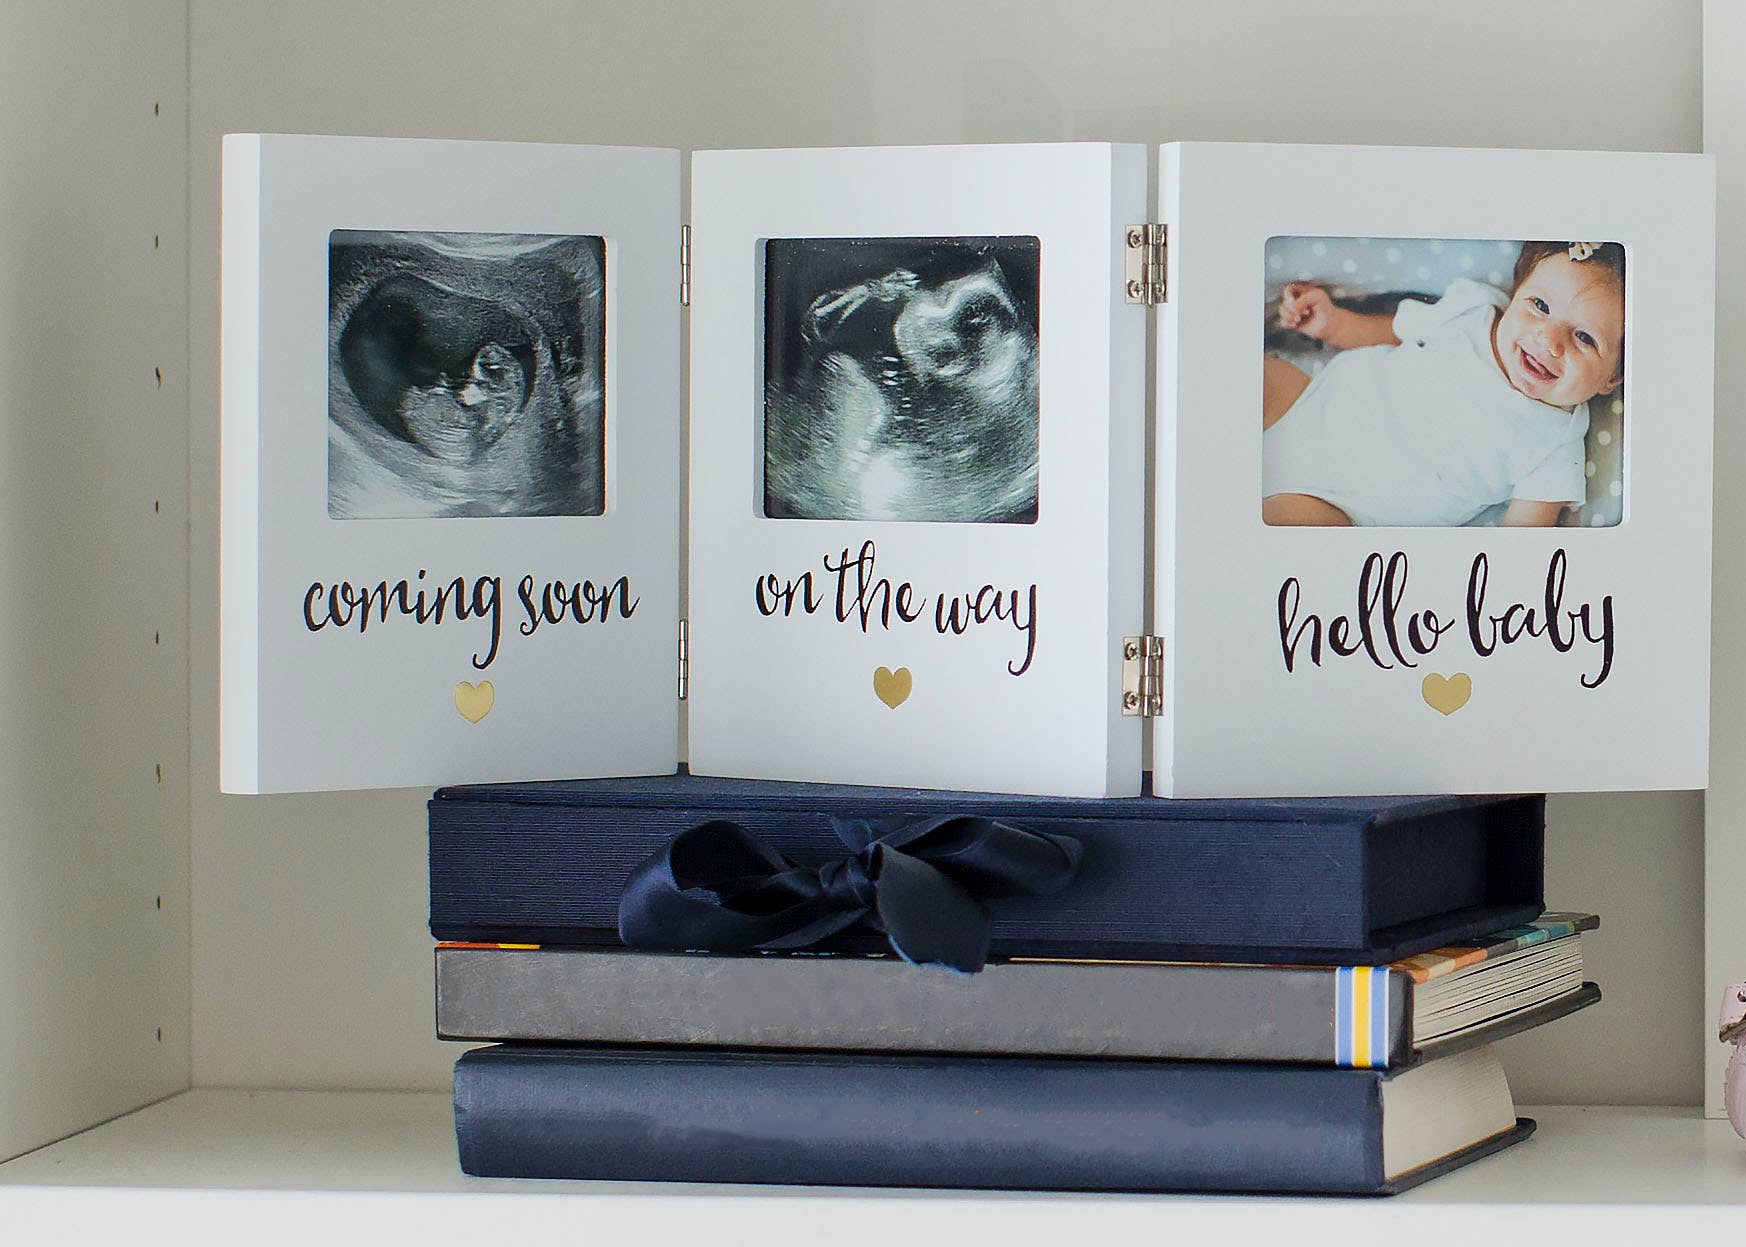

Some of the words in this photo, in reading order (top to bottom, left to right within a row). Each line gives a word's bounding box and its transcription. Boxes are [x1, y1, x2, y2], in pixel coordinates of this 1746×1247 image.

[303, 567, 501, 670] coming
[517, 573, 641, 637] soon
[755, 570, 824, 618] on
[822, 539, 927, 635] the
[935, 583, 1037, 677] way
[1277, 551, 1456, 674] hello
[1466, 548, 1615, 689] baby
